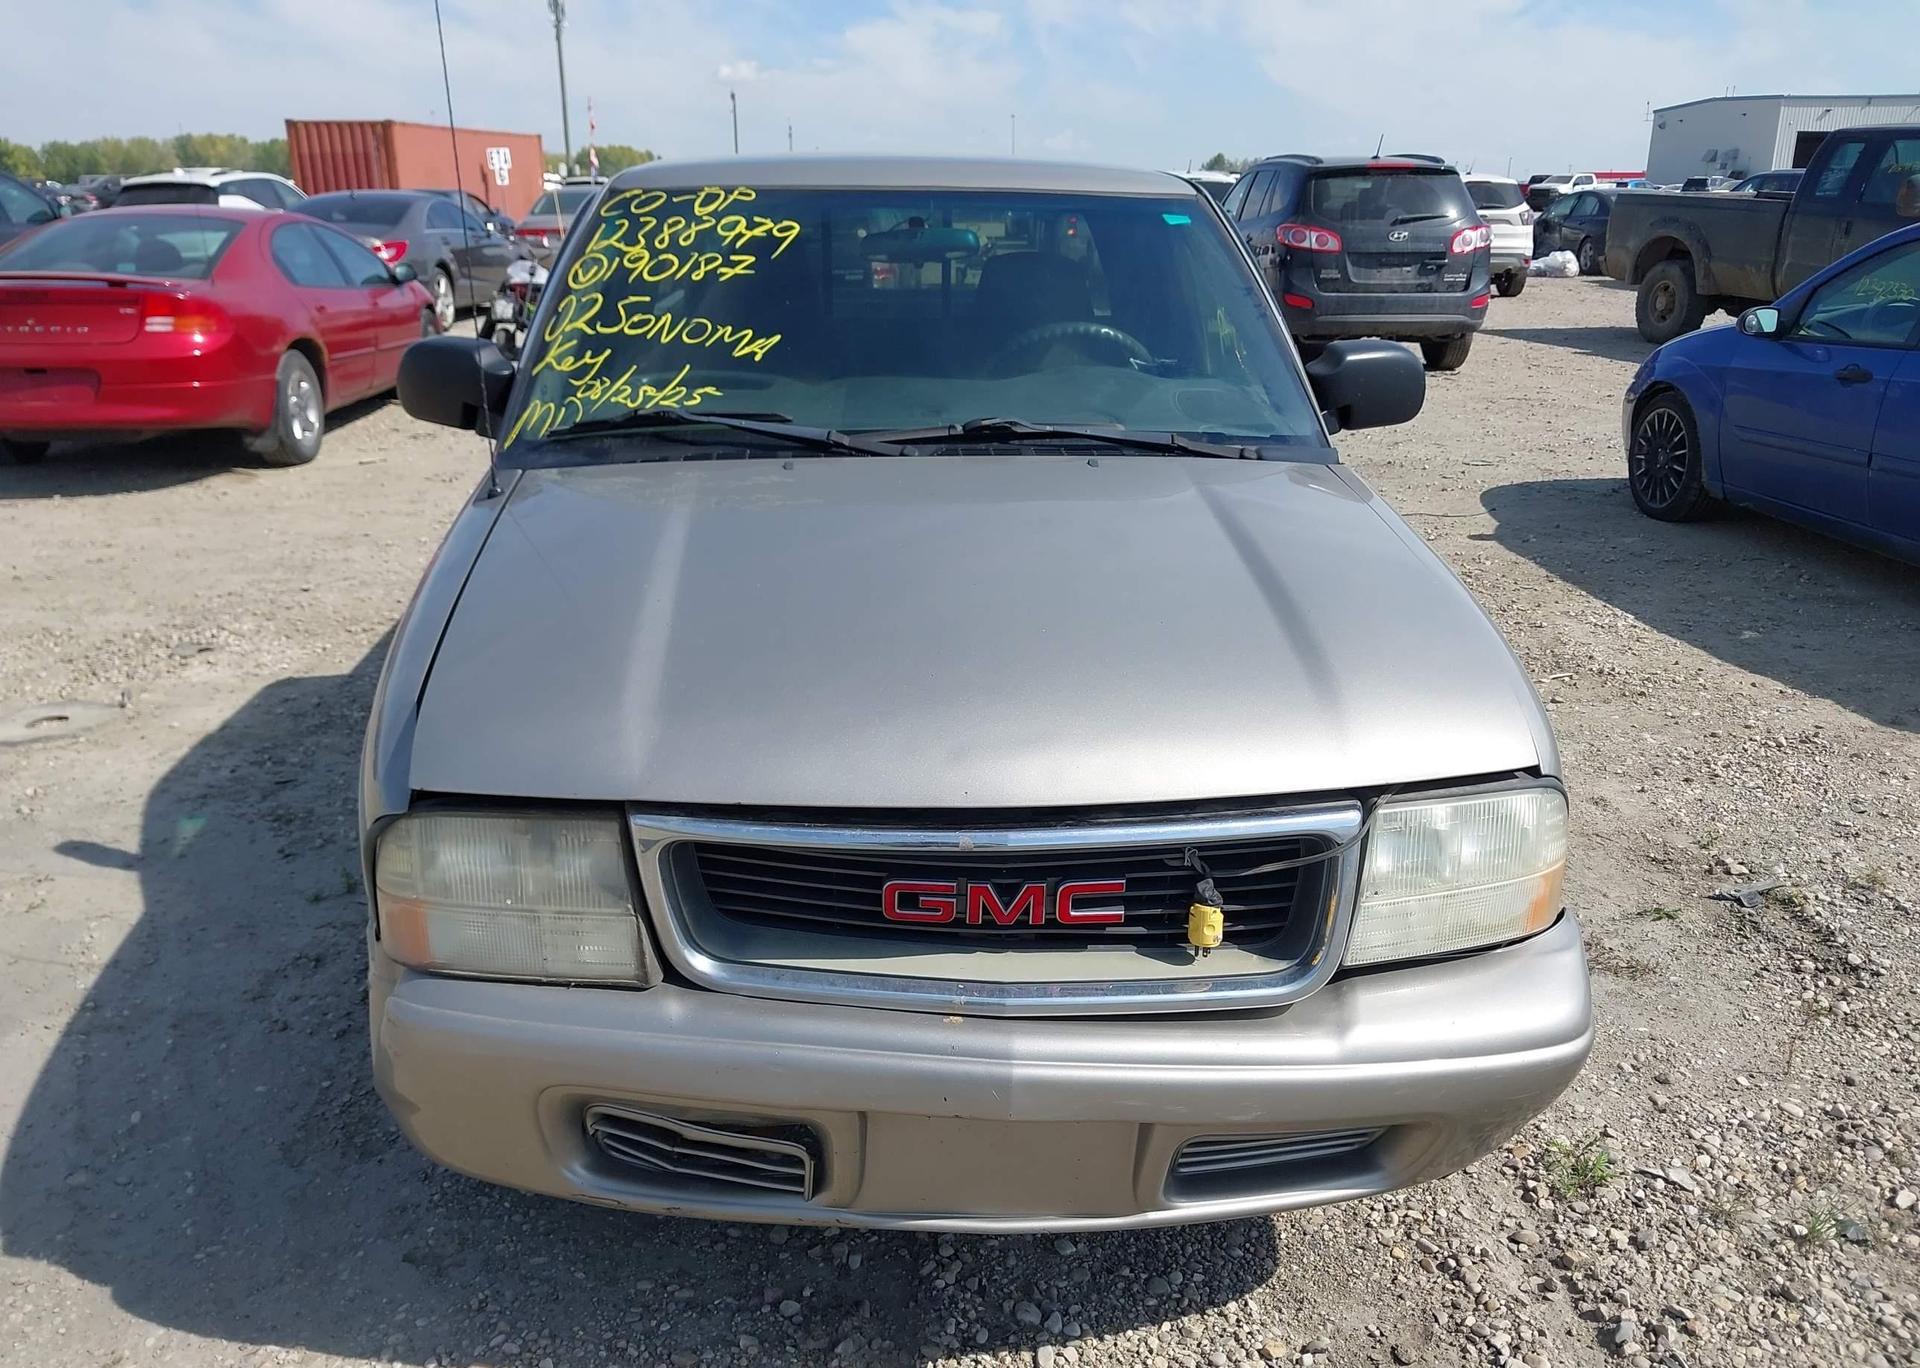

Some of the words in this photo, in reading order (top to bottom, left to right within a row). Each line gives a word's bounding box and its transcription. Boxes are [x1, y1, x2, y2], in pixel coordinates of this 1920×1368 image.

[599, 186, 757, 216] CO-OP
[531, 335, 612, 386] Key
[882, 878, 1127, 925] GMC
